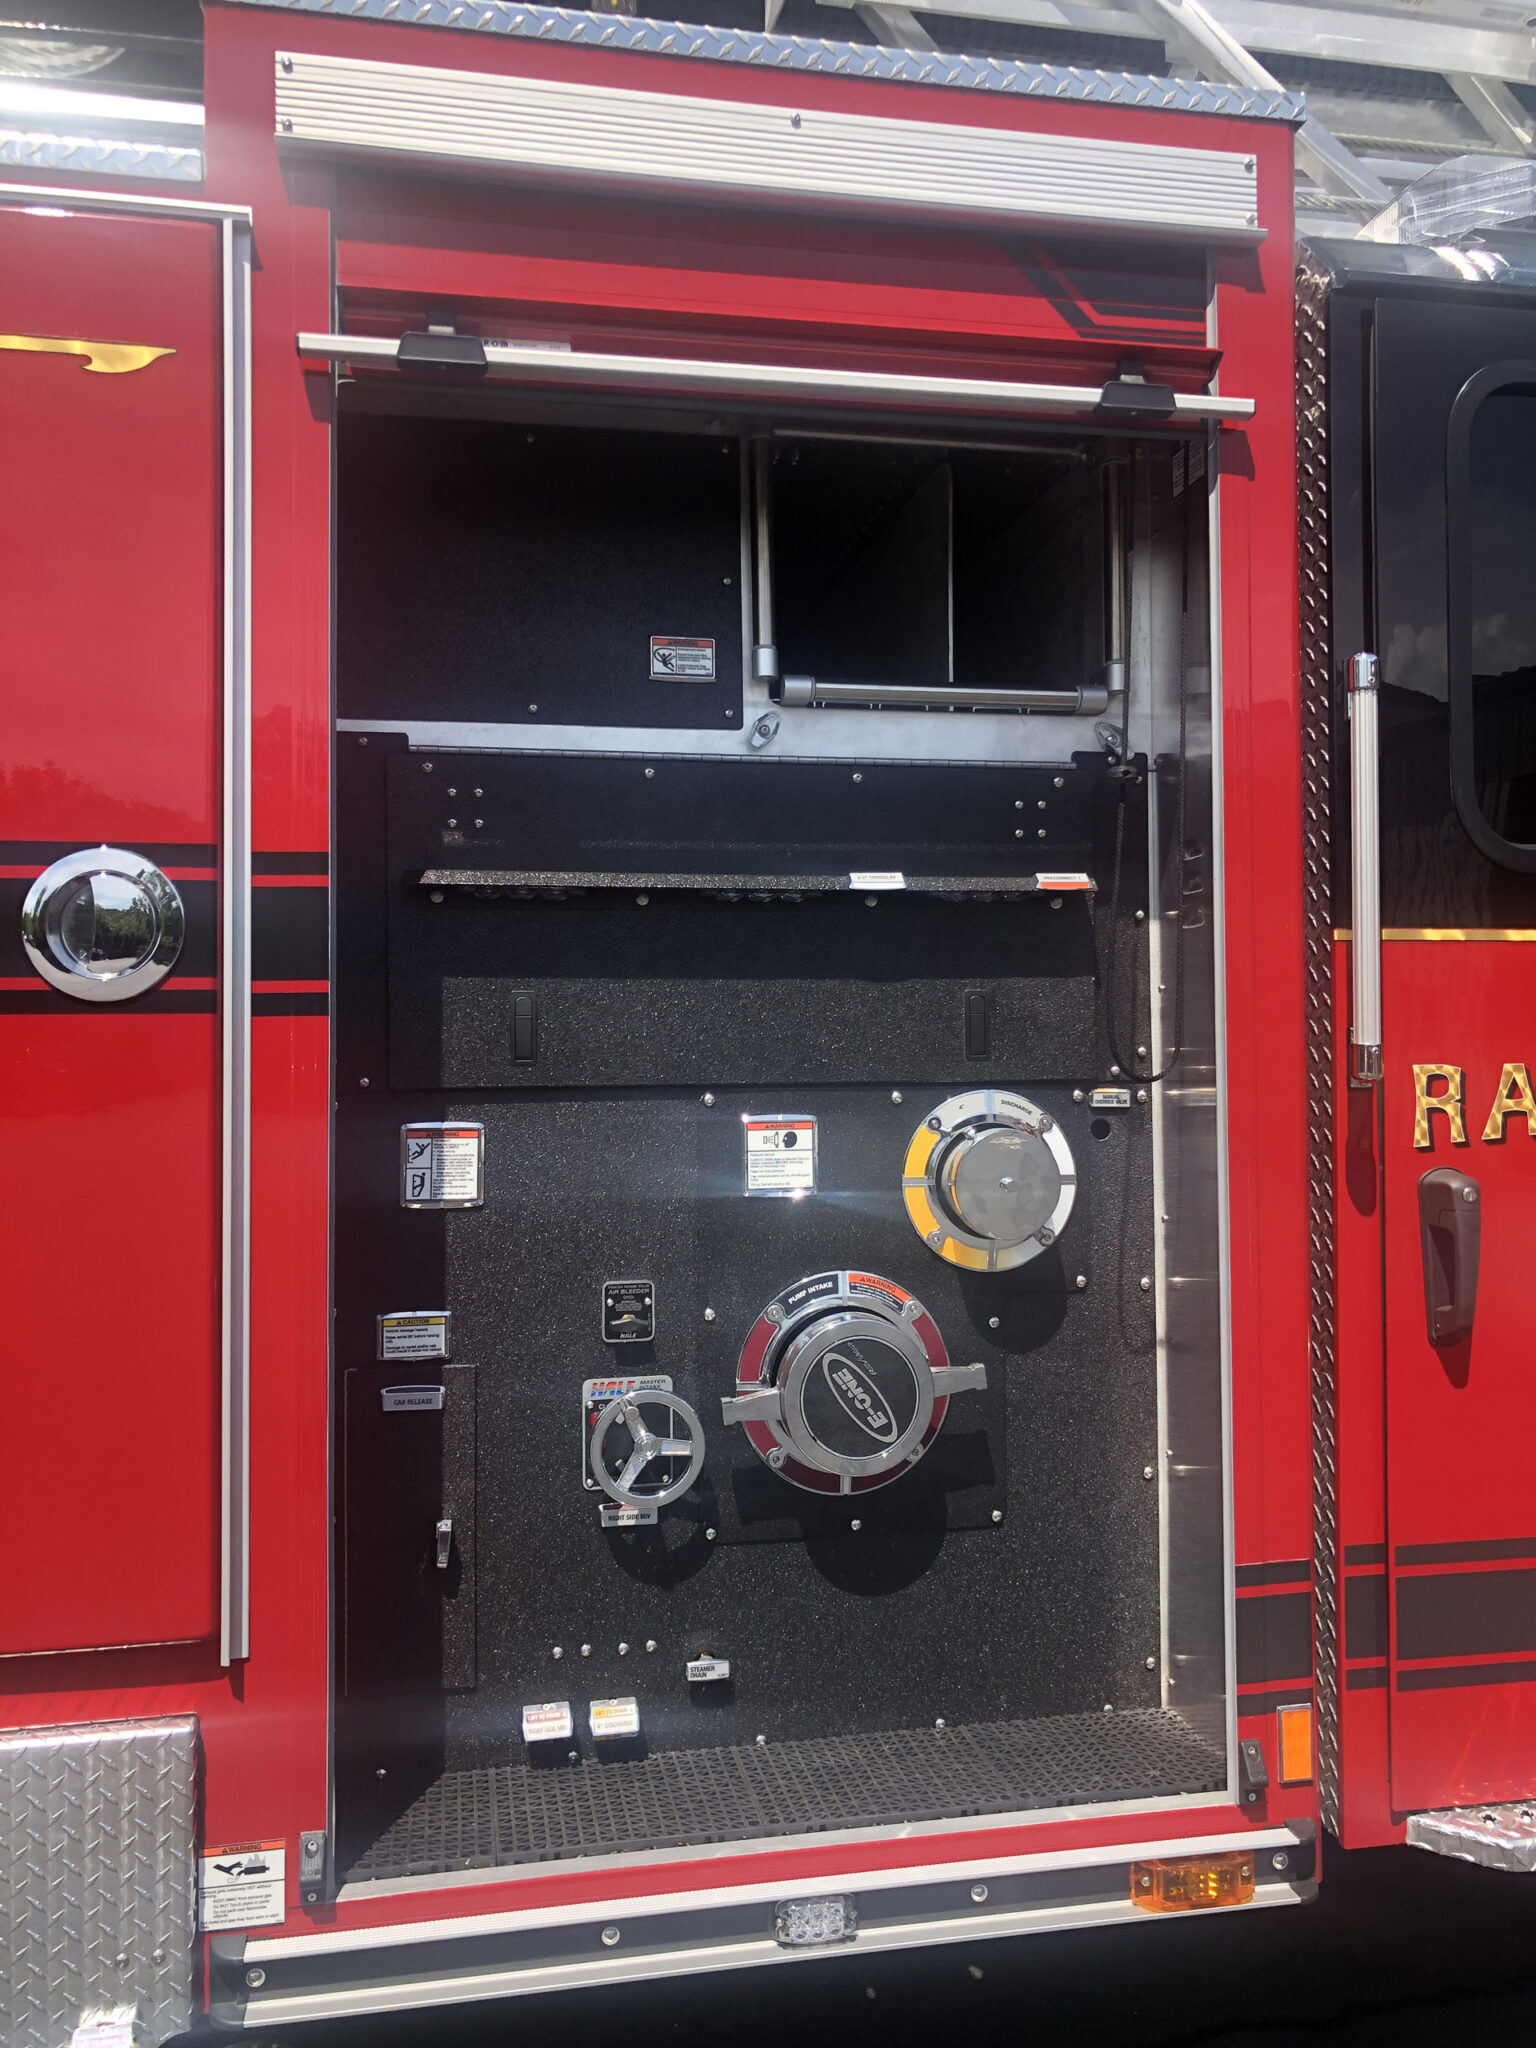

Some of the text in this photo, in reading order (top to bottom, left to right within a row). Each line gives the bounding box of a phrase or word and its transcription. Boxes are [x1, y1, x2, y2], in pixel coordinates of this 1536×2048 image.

[1001, 1100, 1032, 1115] DISCHARGE
[865, 1277, 896, 1292] WARNING
[788, 1281, 833, 1304] PUMP INTAKE
[832, 1368, 889, 1430] E-ONE
[228, 1844, 262, 1852] WARNING
